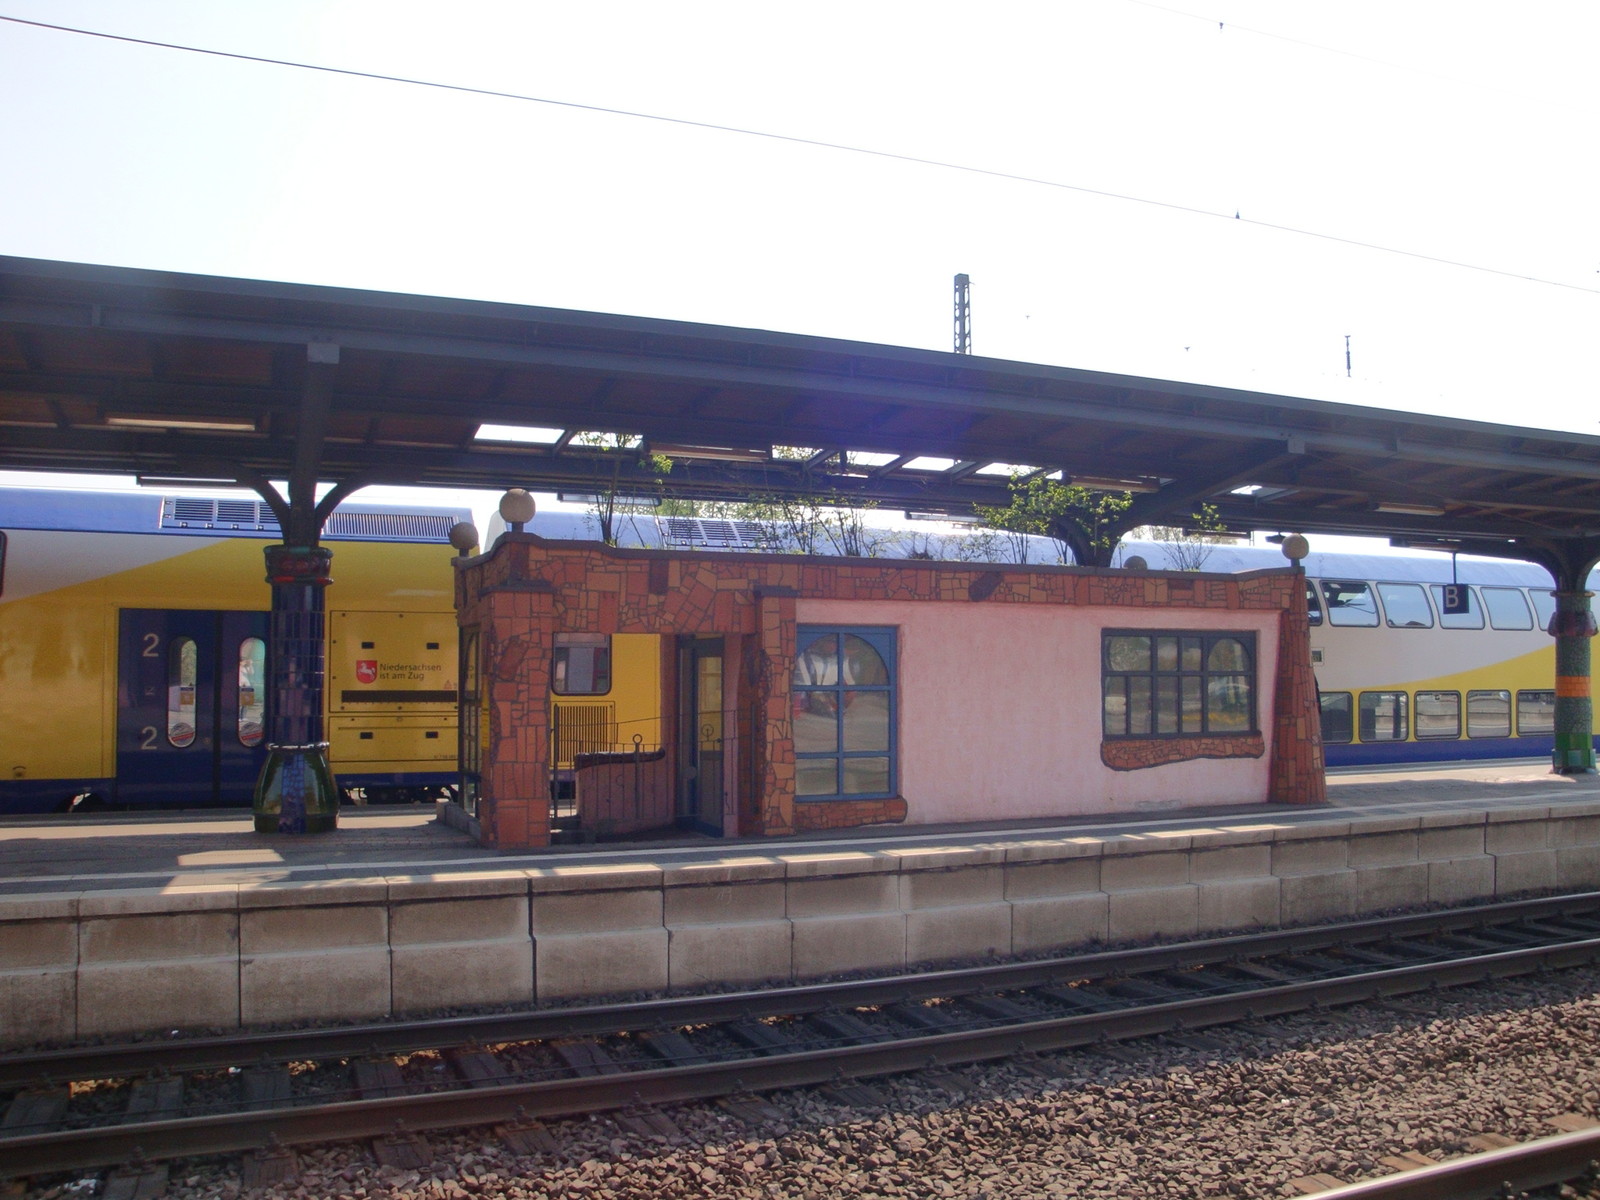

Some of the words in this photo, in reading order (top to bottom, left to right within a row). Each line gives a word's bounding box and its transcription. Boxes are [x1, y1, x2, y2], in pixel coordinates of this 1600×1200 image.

[1445, 586, 1459, 608] B
[142, 633, 160, 657] 2
[379, 663, 442, 671] Niedersachsen
[379, 672, 389, 680] ist
[407, 671, 425, 681] Zug
[140, 726, 158, 750] 2
